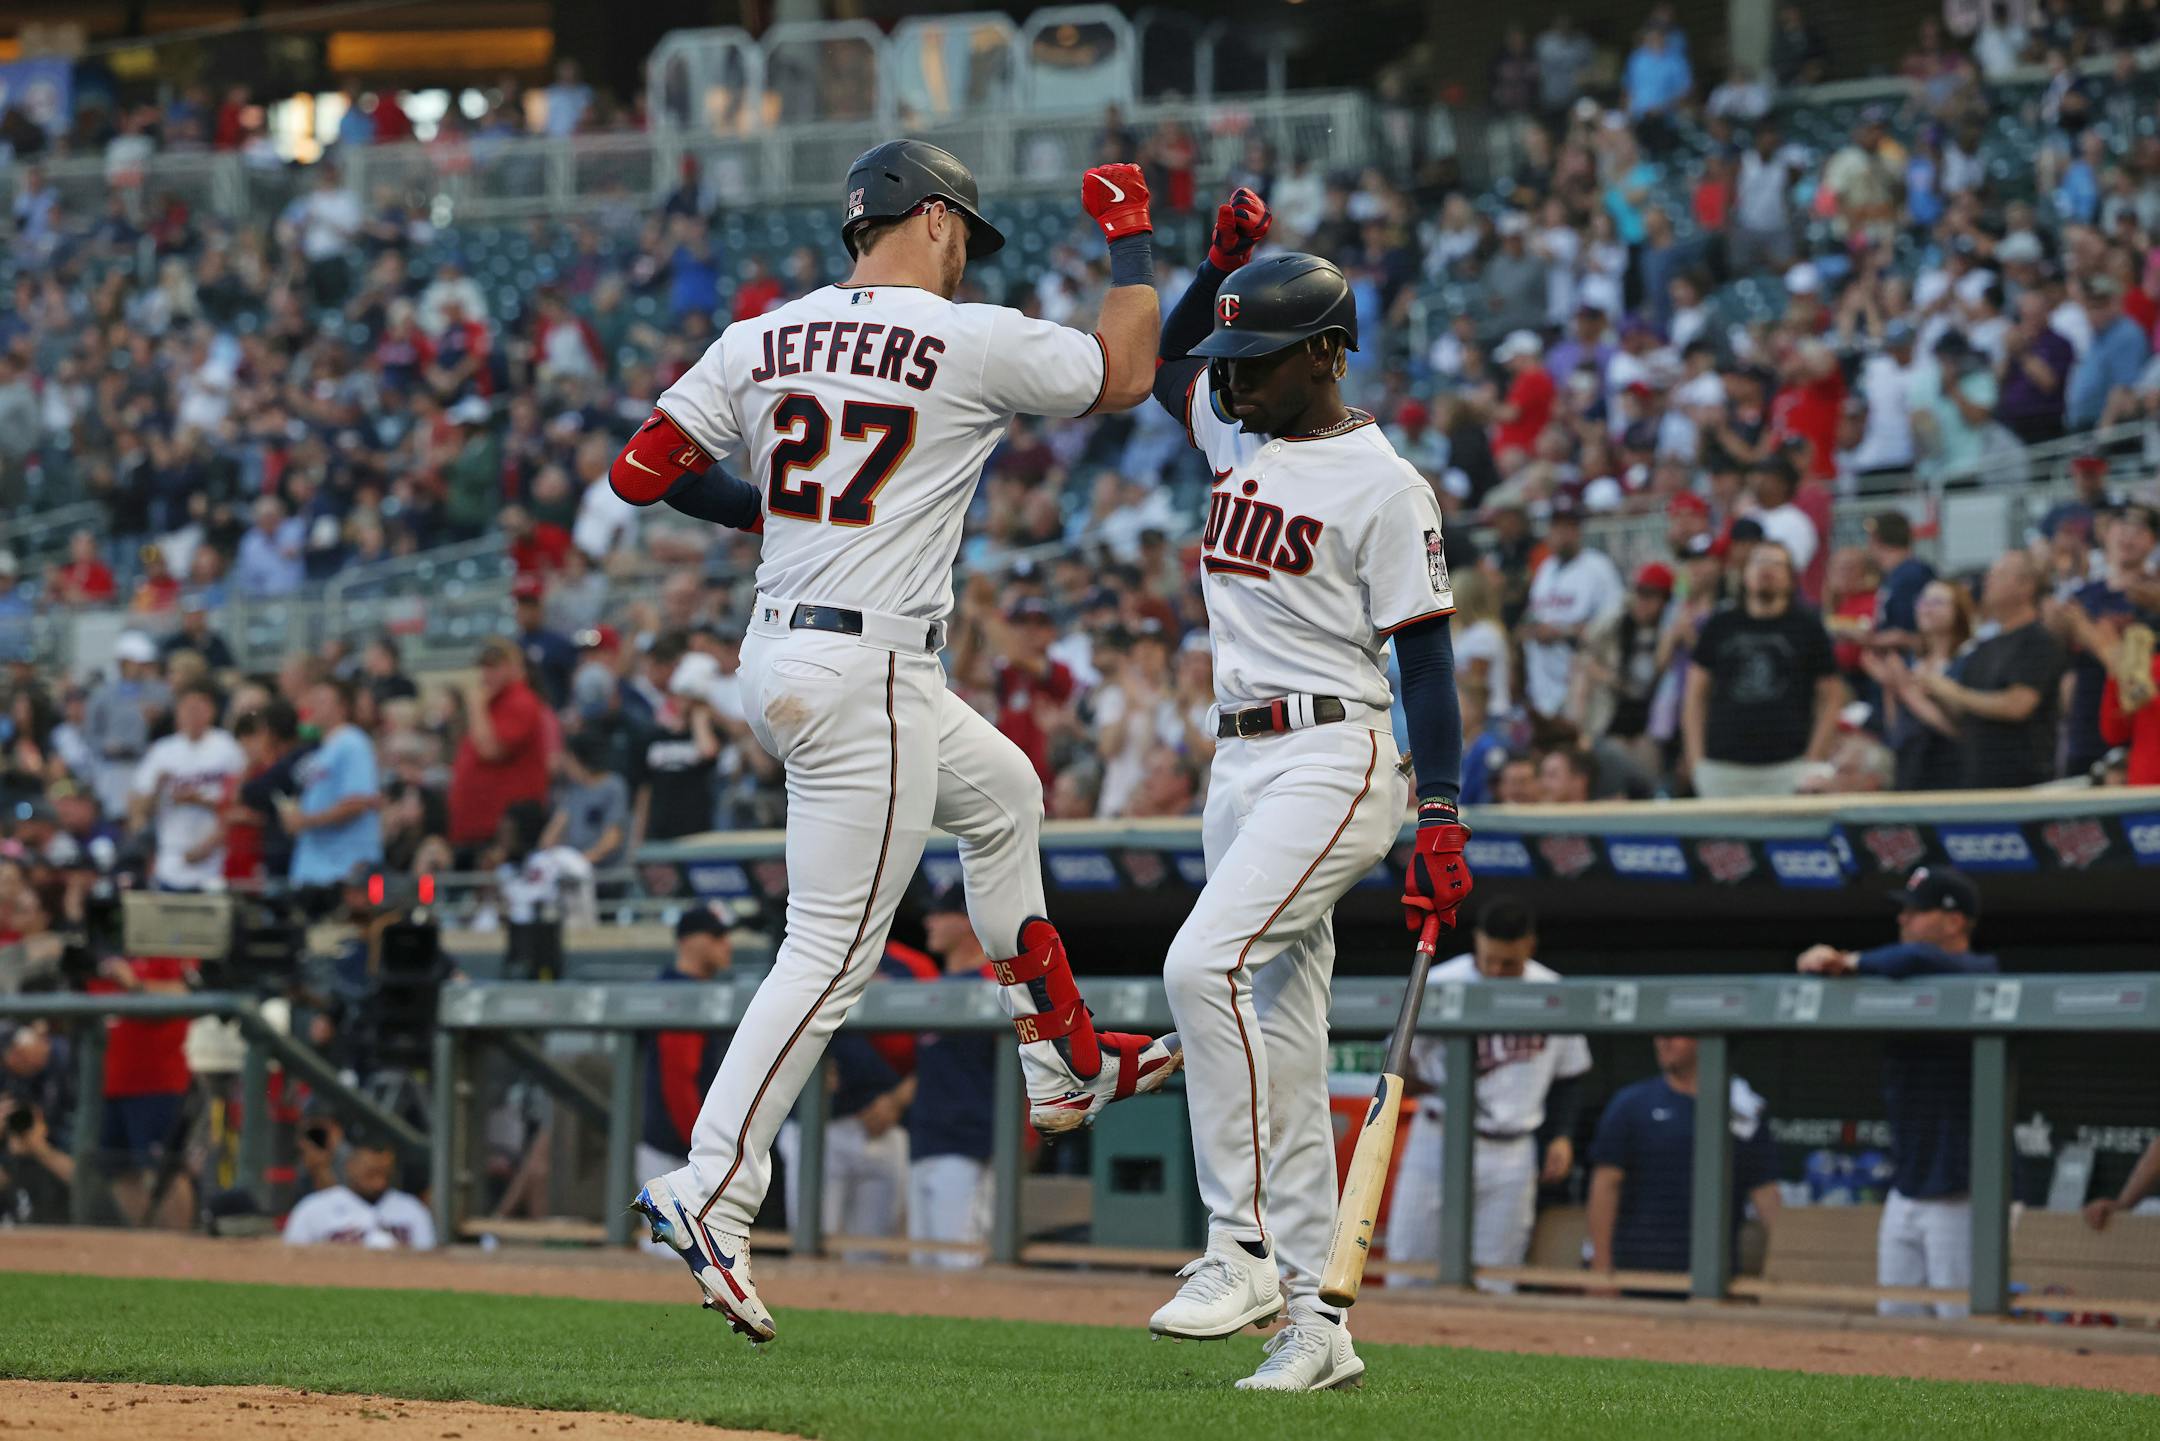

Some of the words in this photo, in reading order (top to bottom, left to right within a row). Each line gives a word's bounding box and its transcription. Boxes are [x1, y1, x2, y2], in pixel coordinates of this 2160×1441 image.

[849, 187, 865, 208] 27
[752, 321, 945, 391] JEFFERS
[768, 393, 918, 528] 27
[1203, 466, 1324, 577] wins
[993, 961, 1016, 985] RS
